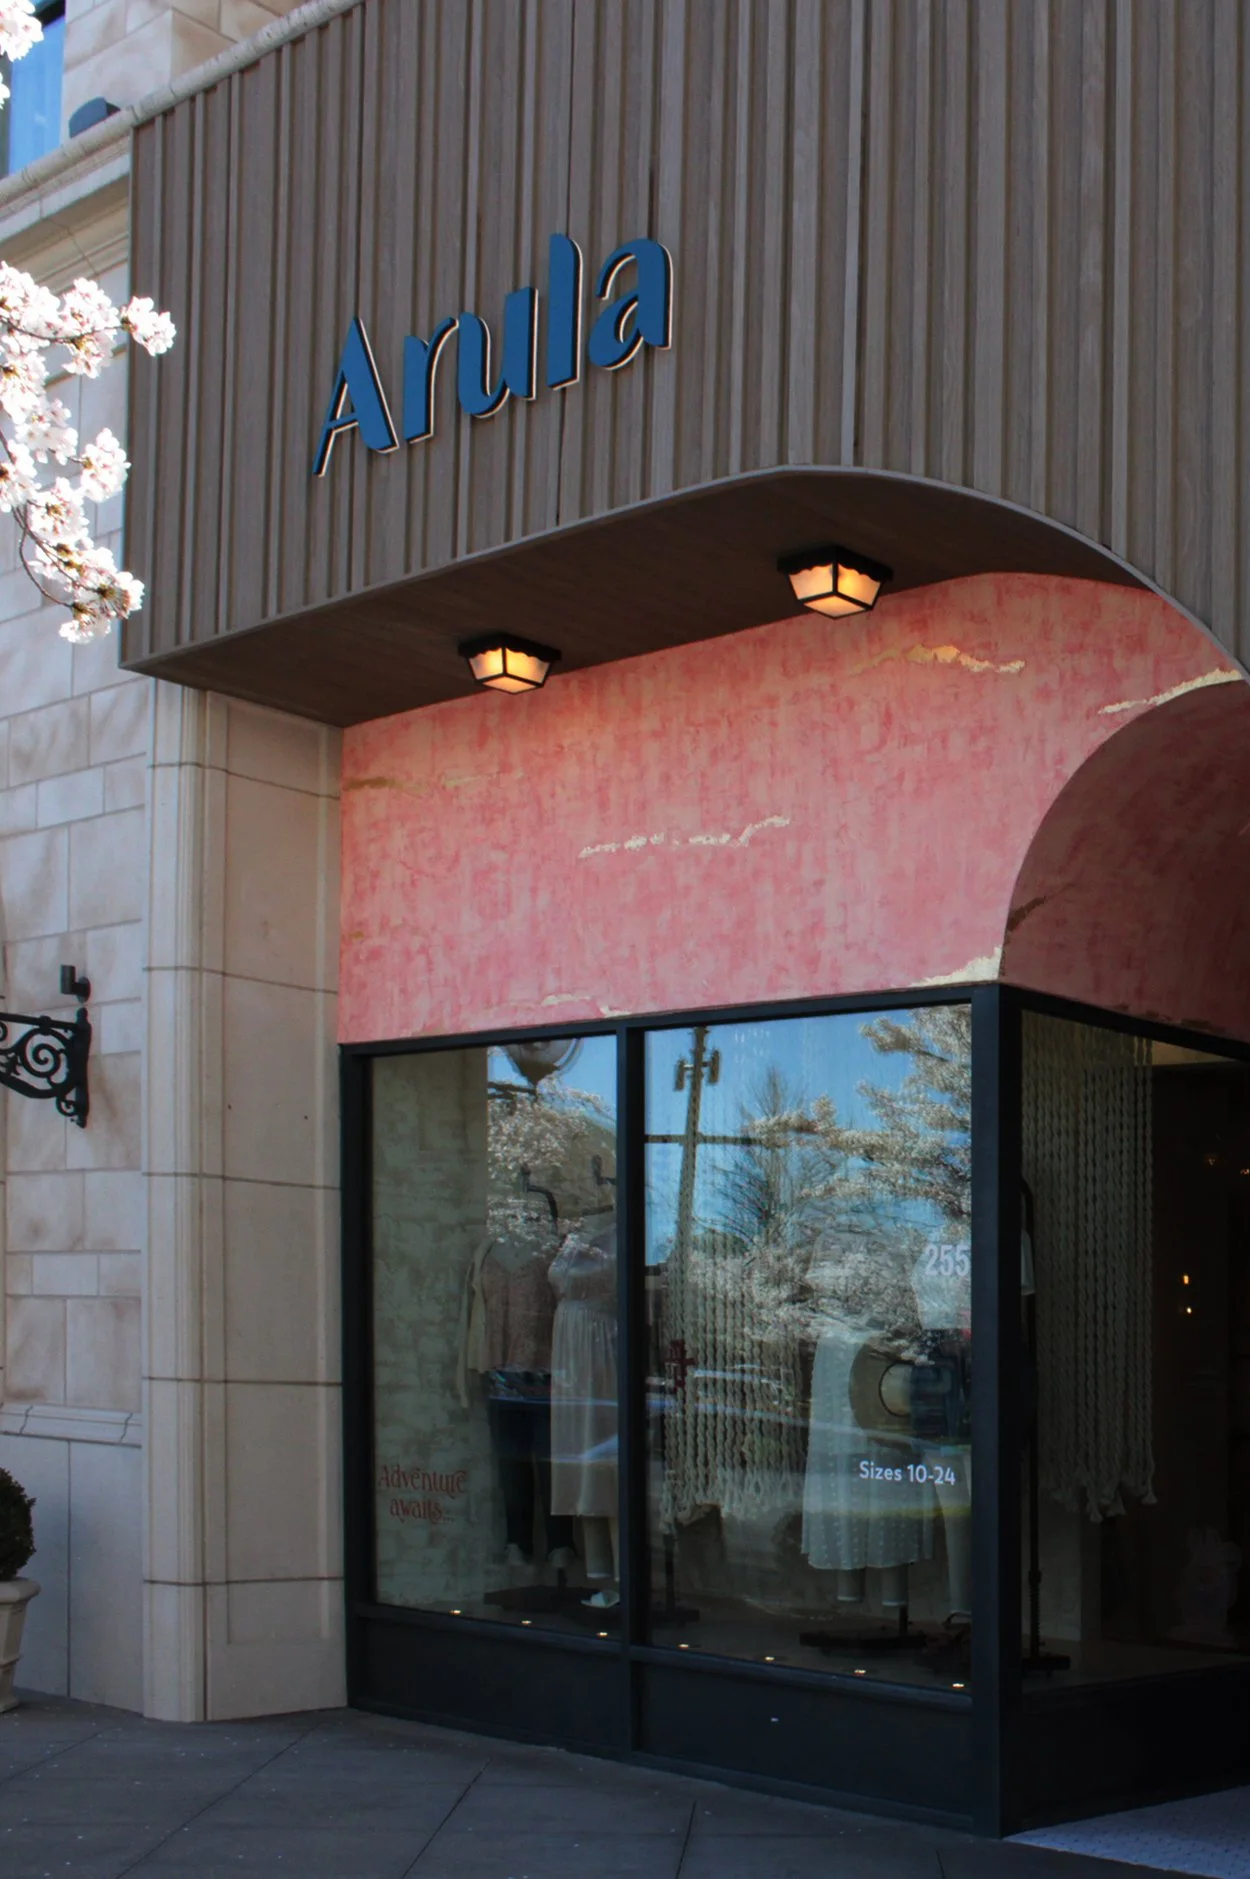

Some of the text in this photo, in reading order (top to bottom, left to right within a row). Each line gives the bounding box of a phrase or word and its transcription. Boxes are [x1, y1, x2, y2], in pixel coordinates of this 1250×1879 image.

[313, 233, 673, 477] Arula
[925, 1243, 970, 1277] 255
[379, 1463, 467, 1499] Adventure
[860, 1460, 956, 1486] Sizes 10-24
